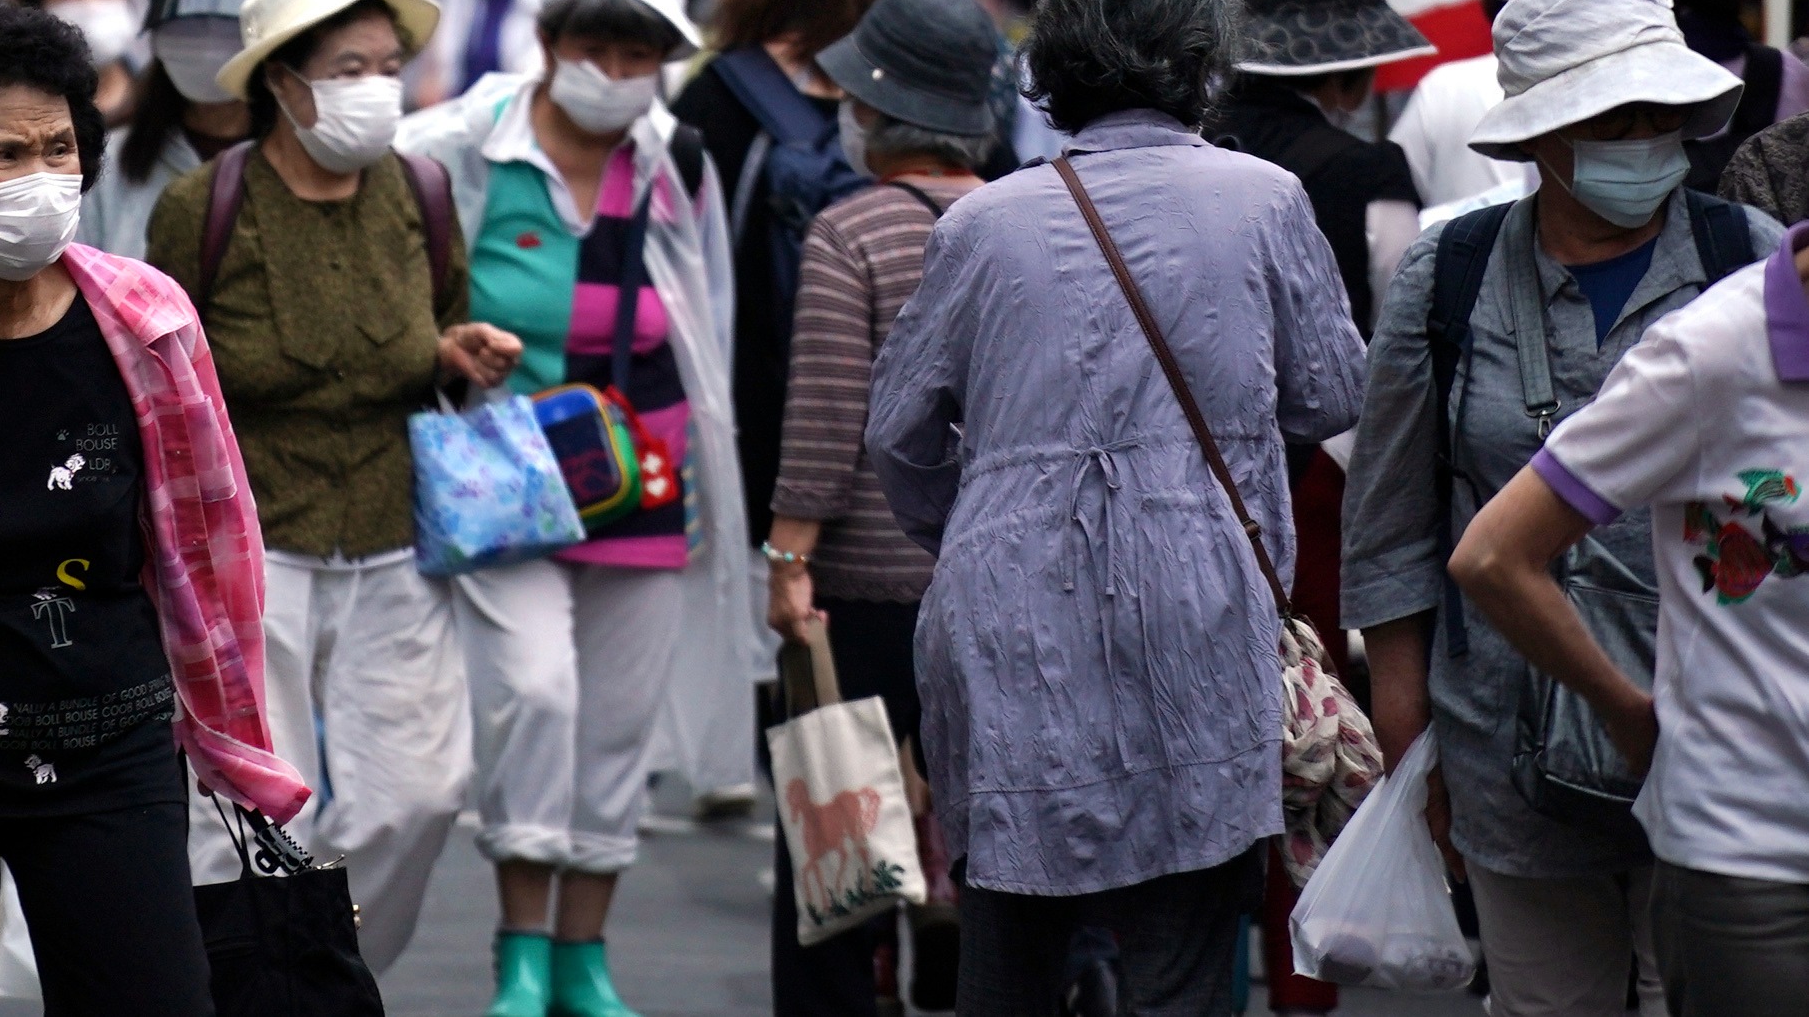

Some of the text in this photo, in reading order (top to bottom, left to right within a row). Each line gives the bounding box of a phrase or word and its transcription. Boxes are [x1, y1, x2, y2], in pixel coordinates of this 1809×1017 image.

[87, 423, 119, 436] BOLL
[76, 437, 118, 451] BOUSE
[56, 558, 90, 591] S
[30, 597, 76, 650] T
[120, 683, 147, 702] GOOD
[35, 712, 60, 727] BOLL
[65, 708, 99, 725] BOUSE
[101, 701, 134, 719] COOB
[63, 734, 98, 751] BOUSE
